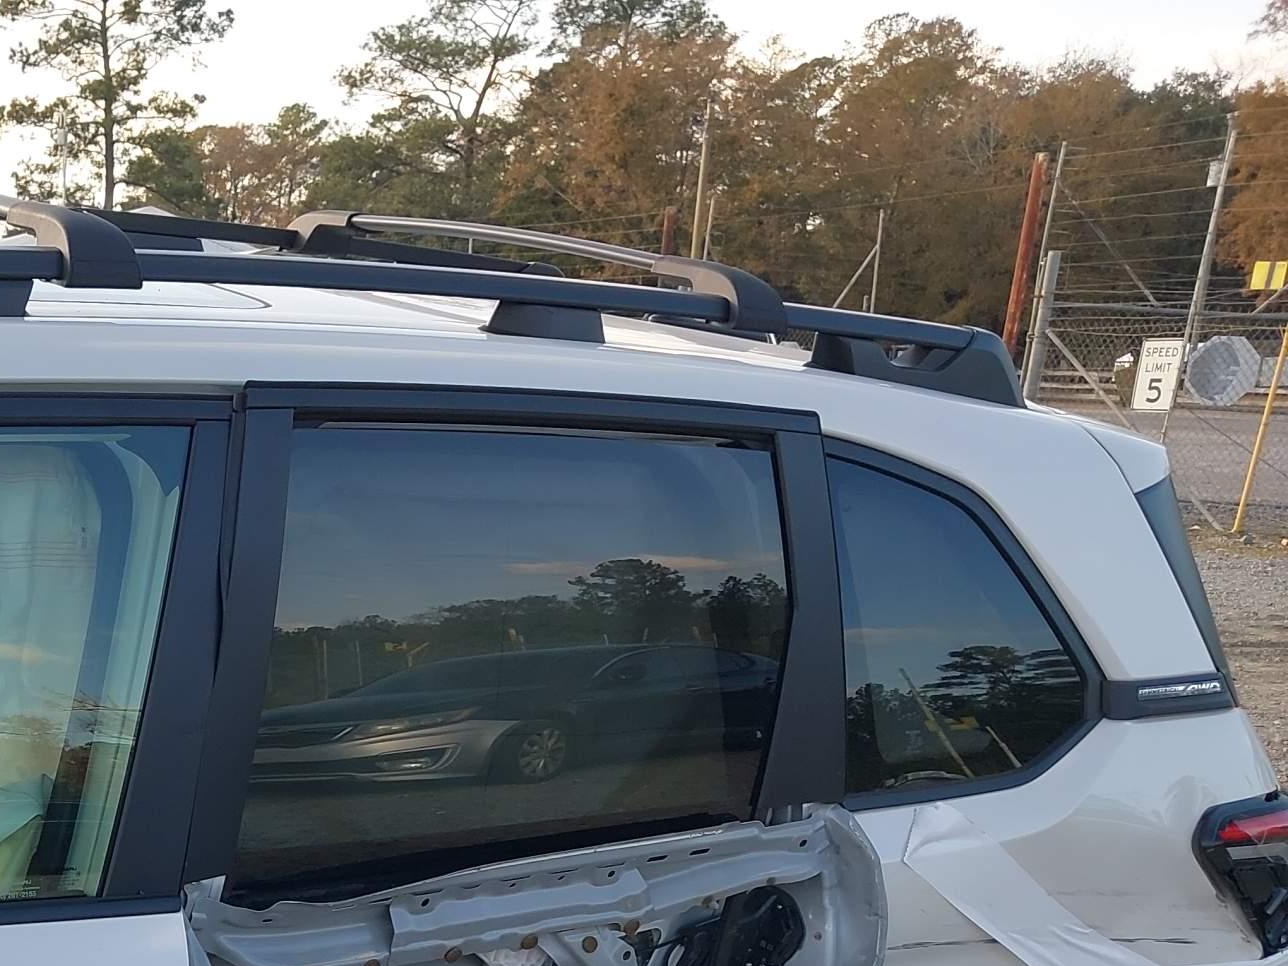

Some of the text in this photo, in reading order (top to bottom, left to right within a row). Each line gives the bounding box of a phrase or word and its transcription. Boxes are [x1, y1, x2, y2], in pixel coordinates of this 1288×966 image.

[1145, 347, 1179, 357] SPEED
[1145, 362, 1173, 373] LIMIT
[1146, 378, 1163, 403] 5
